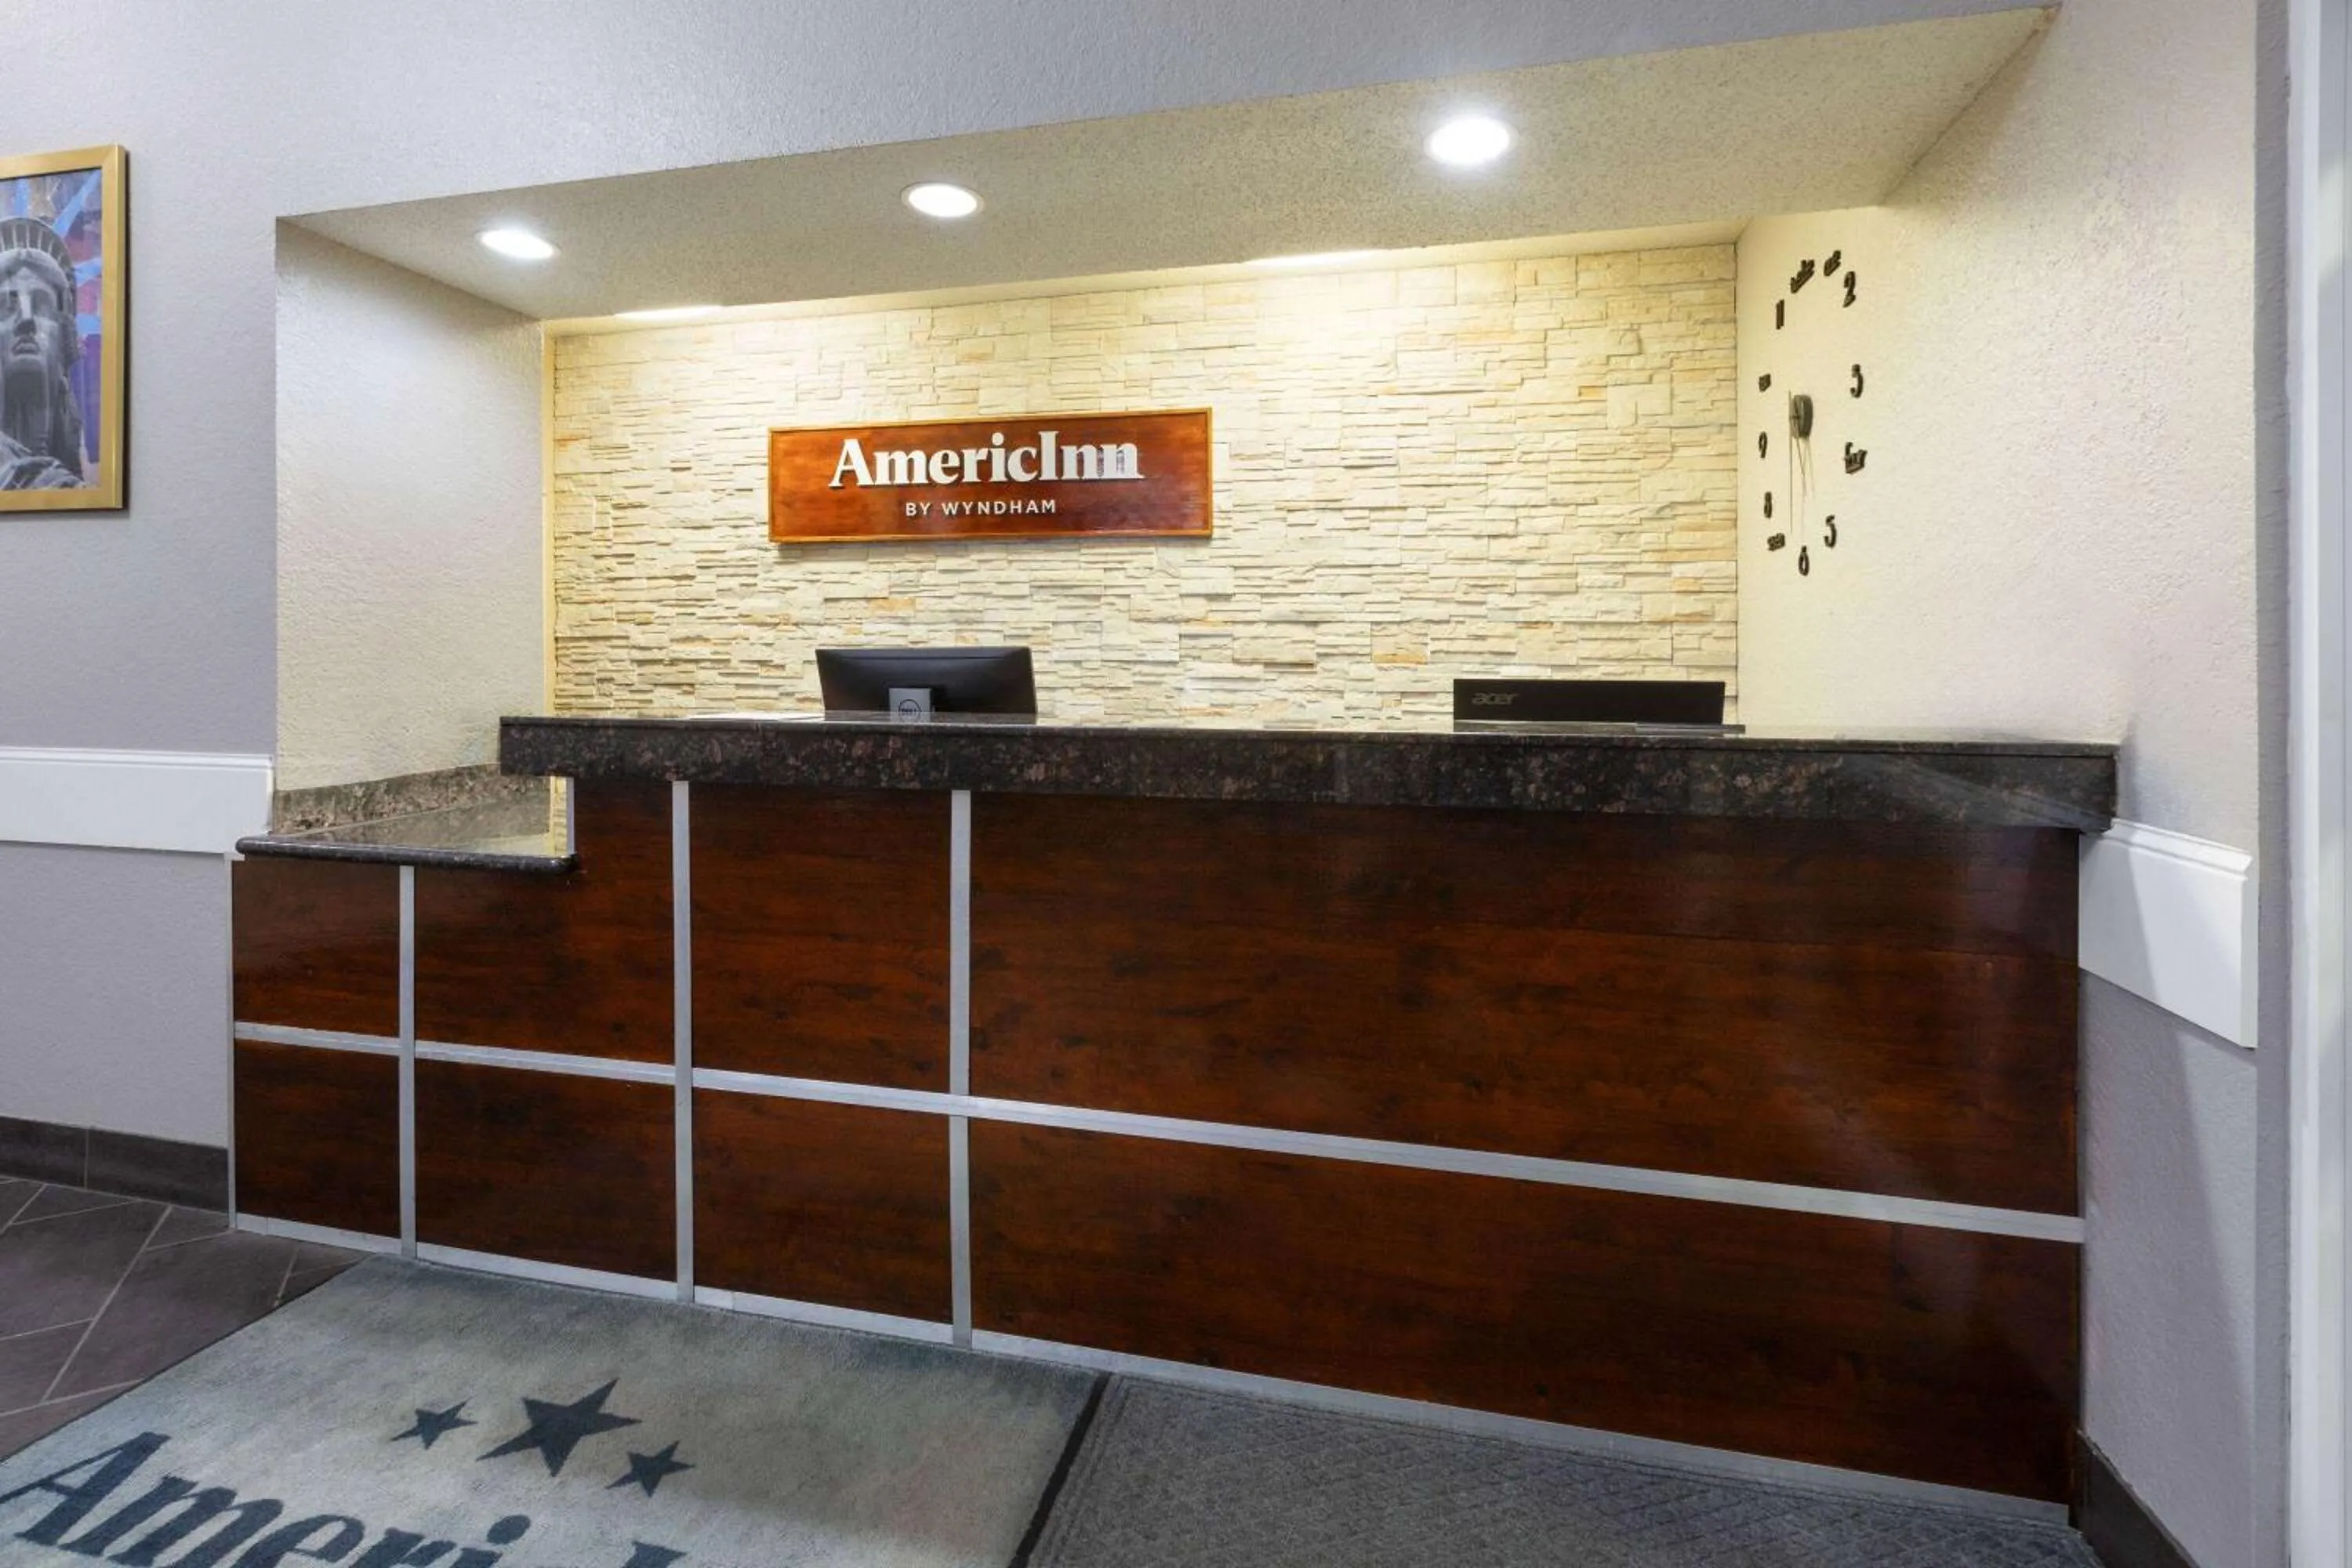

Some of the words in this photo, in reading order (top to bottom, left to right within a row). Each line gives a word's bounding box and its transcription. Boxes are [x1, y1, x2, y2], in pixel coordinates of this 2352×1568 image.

[1843, 270, 1857, 308] 2
[1849, 364, 1864, 398] 3
[828, 431, 1145, 487] AmericInn
[1758, 432, 1768, 459] 9
[905, 502, 931, 517] BY
[942, 499, 1056, 515] WYNDHAM
[1824, 515, 1837, 549] 5
[1798, 546, 1809, 576] 6
[1472, 692, 1519, 706] acer
